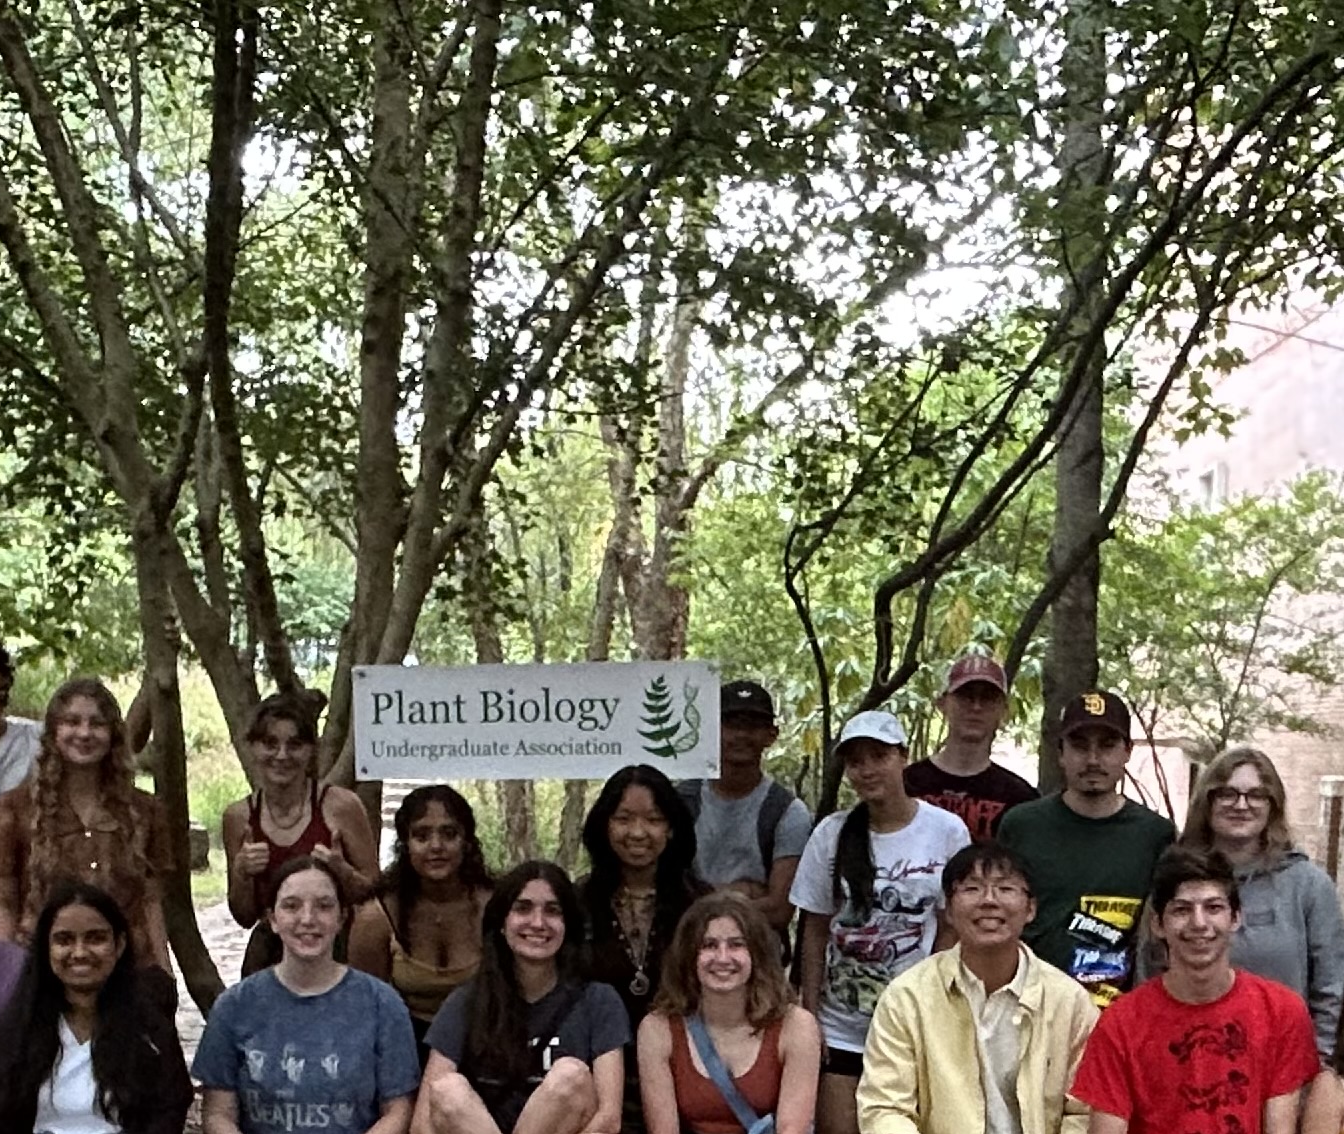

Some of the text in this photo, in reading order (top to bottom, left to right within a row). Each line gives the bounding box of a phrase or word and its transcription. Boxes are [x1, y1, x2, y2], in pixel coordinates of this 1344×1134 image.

[371, 687, 620, 731] Plant Biology
[371, 736, 622, 761] Undergraduate Association
[245, 1089, 330, 1131] BEATLES
